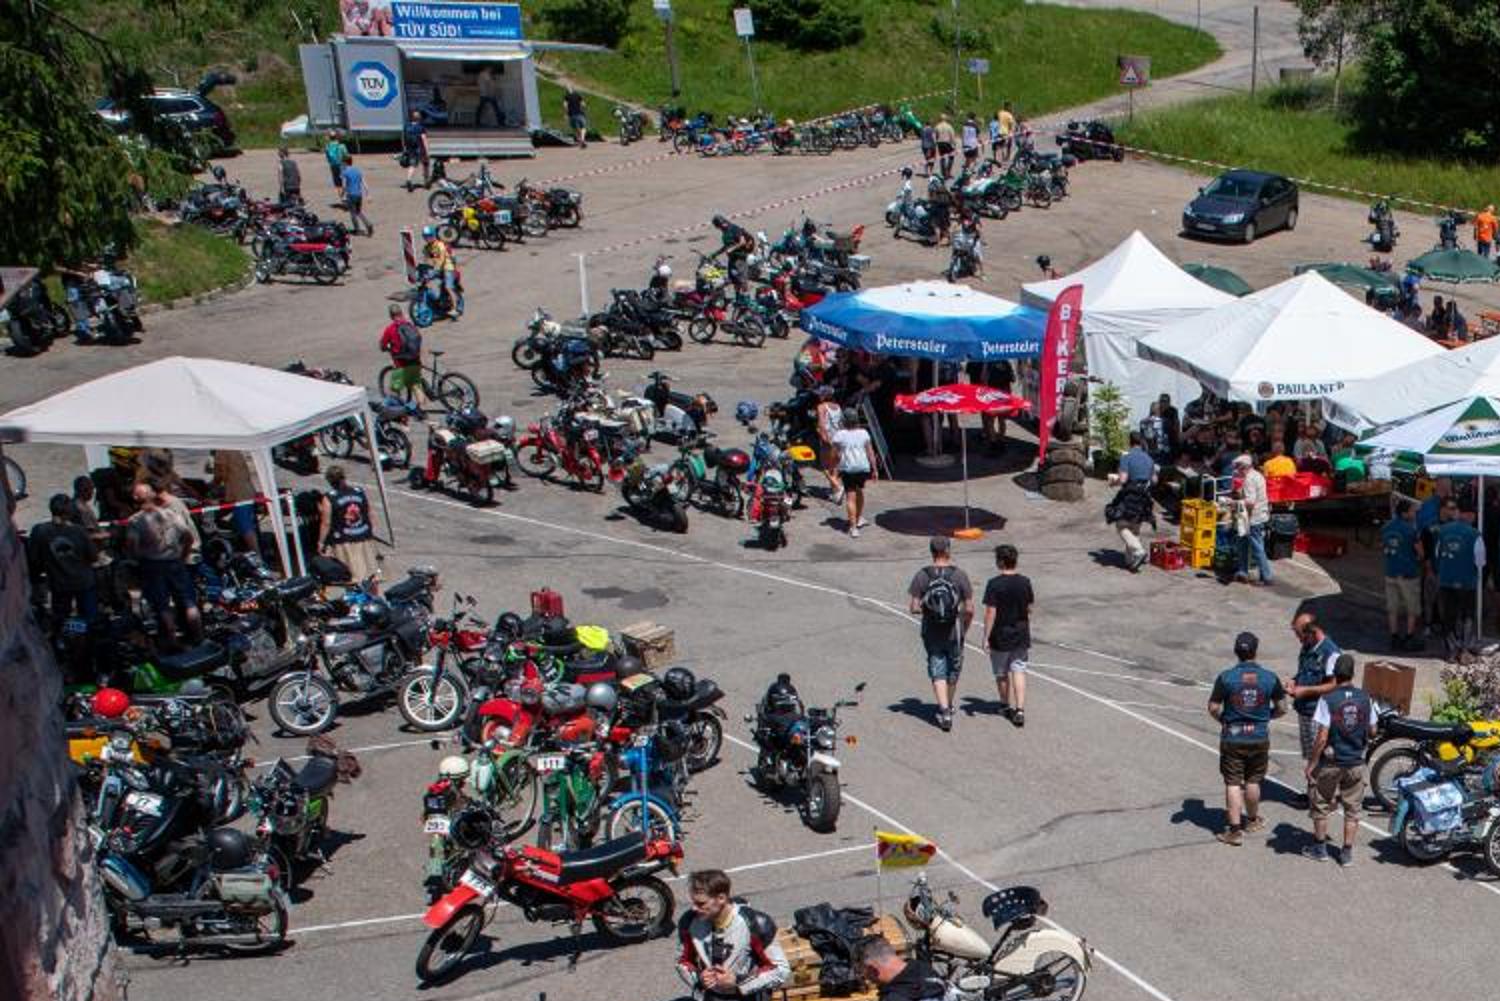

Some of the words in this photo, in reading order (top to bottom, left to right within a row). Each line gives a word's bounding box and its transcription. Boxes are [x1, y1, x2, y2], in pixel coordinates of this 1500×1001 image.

[396, 4, 479, 19] Willkommen
[481, 8, 501, 20] bei
[399, 22, 426, 37] TÜV
[429, 23, 462, 37] SÜD!
[360, 77, 385, 90] TÜV
